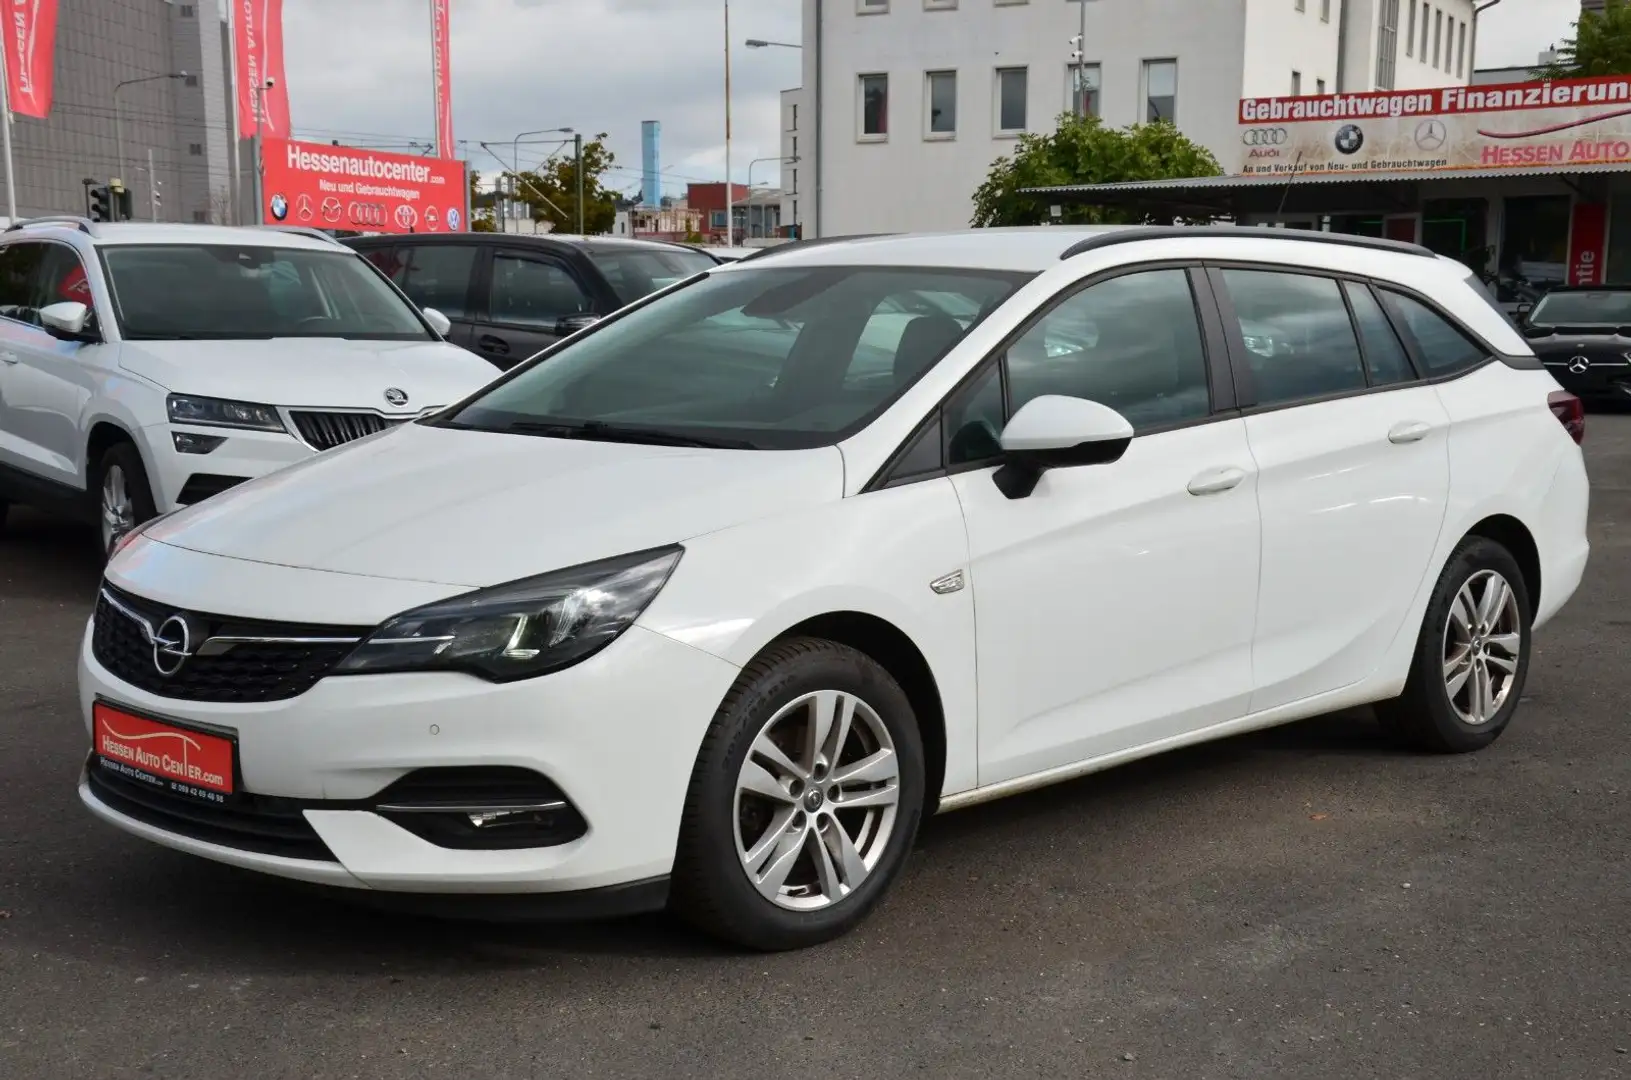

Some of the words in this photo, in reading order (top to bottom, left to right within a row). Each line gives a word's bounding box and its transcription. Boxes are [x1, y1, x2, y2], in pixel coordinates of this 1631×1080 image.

[1242, 94, 1432, 120] Gebrauchtwagen
[1441, 79, 1631, 111] Finanzierun
[1482, 143, 1563, 165] HESSEN
[1569, 140, 1630, 161] AUTO
[1242, 164, 1254, 173] An
[1256, 164, 1272, 173] und
[1274, 162, 1307, 172] Verkauf
[1310, 163, 1325, 171] von
[1328, 161, 1349, 170] Neu-
[1351, 160, 1369, 170] und
[1371, 158, 1447, 169] Gebrauchtwagen
[319, 179, 337, 191] Neu
[338, 181, 353, 194] und
[355, 183, 420, 201] Gebrauchtwagen
[102, 735, 134, 761] HESSEN
[136, 746, 160, 769] AUTO
